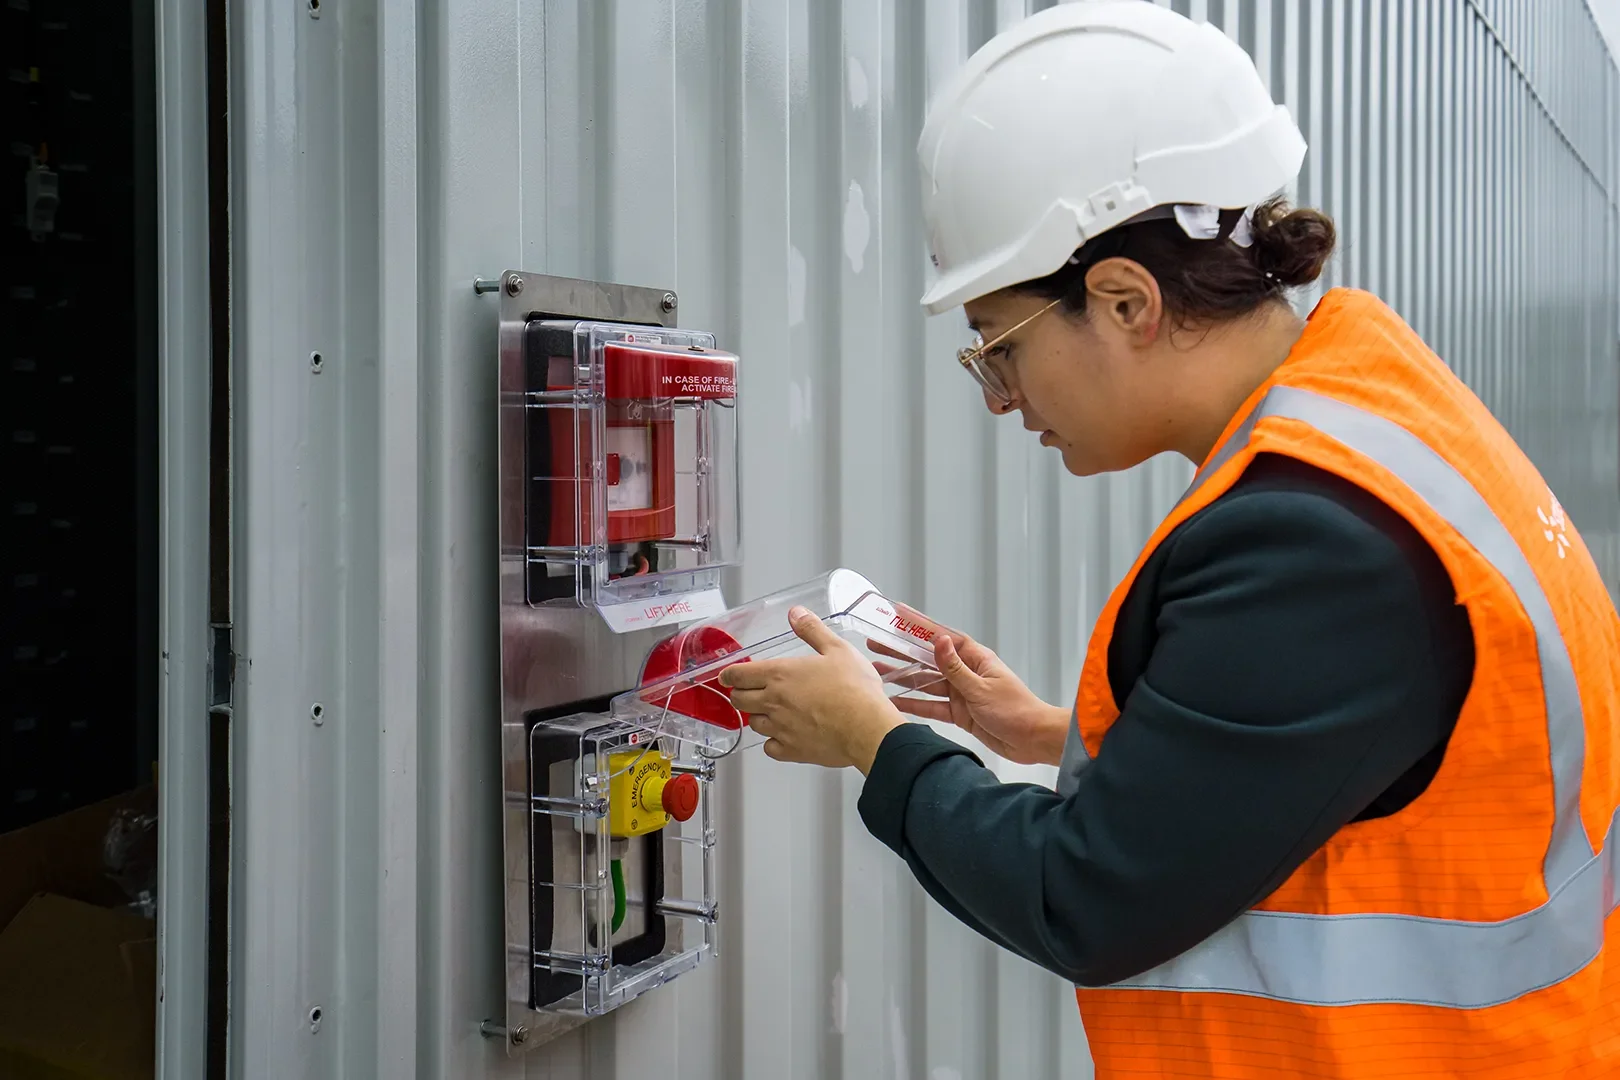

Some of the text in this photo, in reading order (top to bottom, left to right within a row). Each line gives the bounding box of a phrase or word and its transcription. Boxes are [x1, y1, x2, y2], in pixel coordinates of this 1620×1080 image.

[662, 376, 672, 384] IN
[674, 376, 700, 384] CASE
[702, 376, 712, 384] OF
[681, 384, 720, 392] ACTIVATE
[644, 606, 665, 619] LIFT
[666, 602, 692, 616] HERE
[632, 762, 662, 808] EMERGENCY
